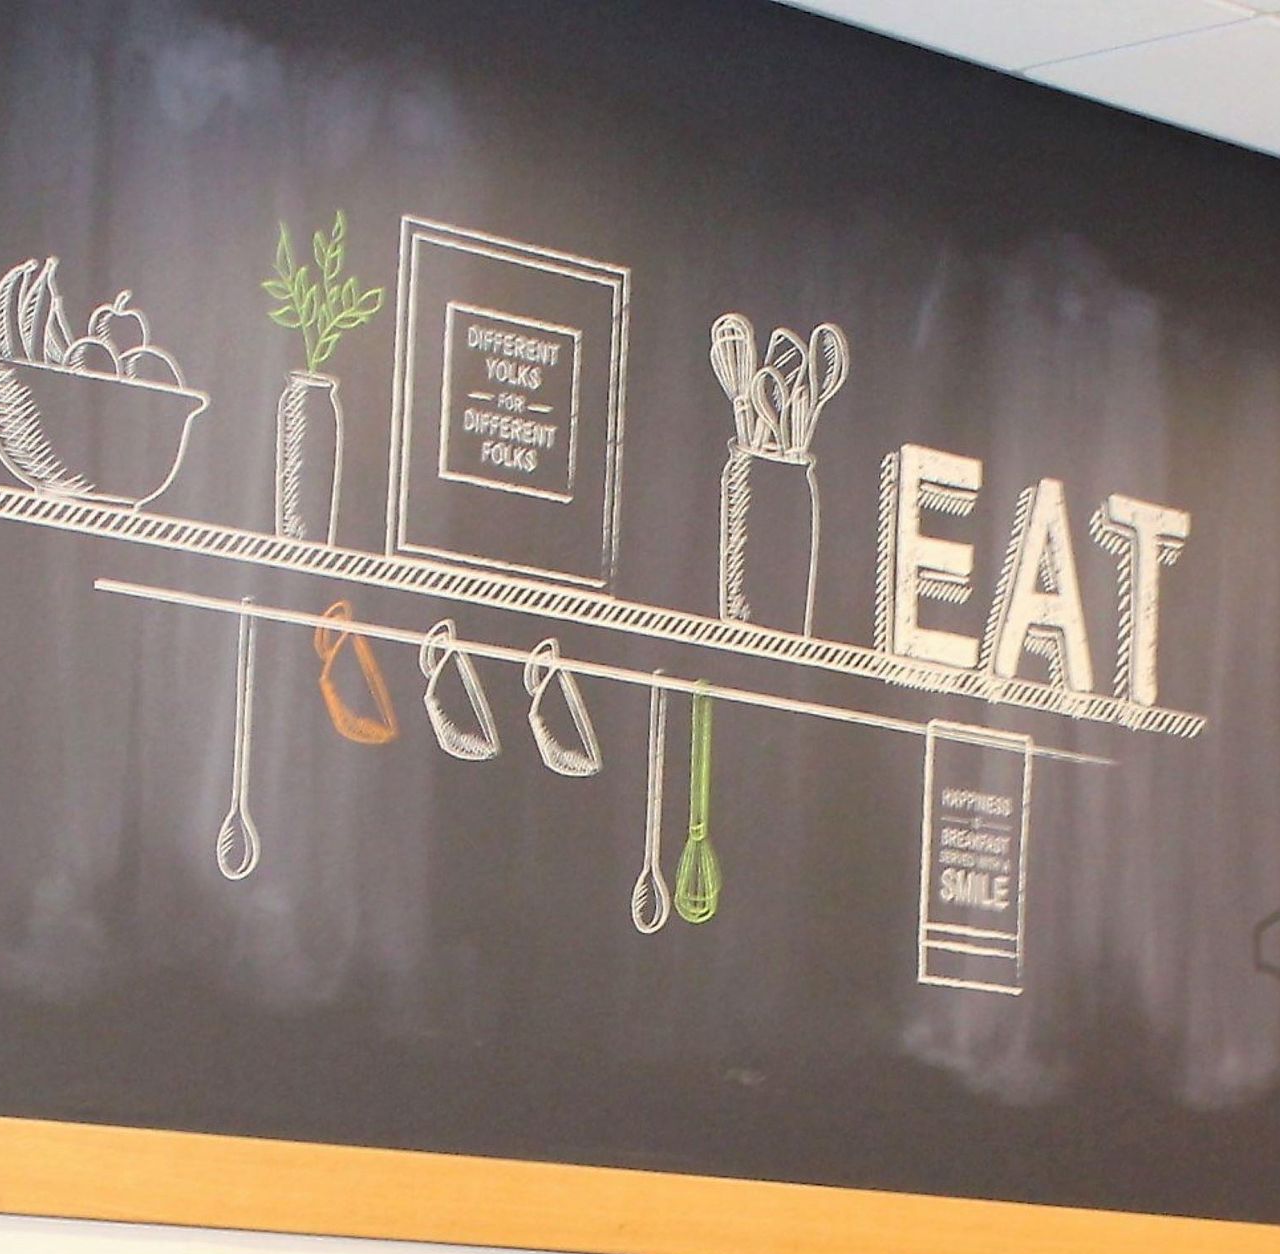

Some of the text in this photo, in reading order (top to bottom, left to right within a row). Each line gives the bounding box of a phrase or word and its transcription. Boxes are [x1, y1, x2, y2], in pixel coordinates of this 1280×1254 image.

[468, 326, 561, 367] DIFFERENT
[485, 358, 543, 391] YOLKS
[497, 392, 527, 411] FOR
[464, 408, 558, 448] DIFFERENT
[481, 442, 539, 473] FOLKS
[875, 443, 1192, 707] EAT
[941, 787, 1013, 817] HAPPINESS
[941, 827, 1011, 856] BREAKFAST
[939, 867, 1011, 912] SMILE
